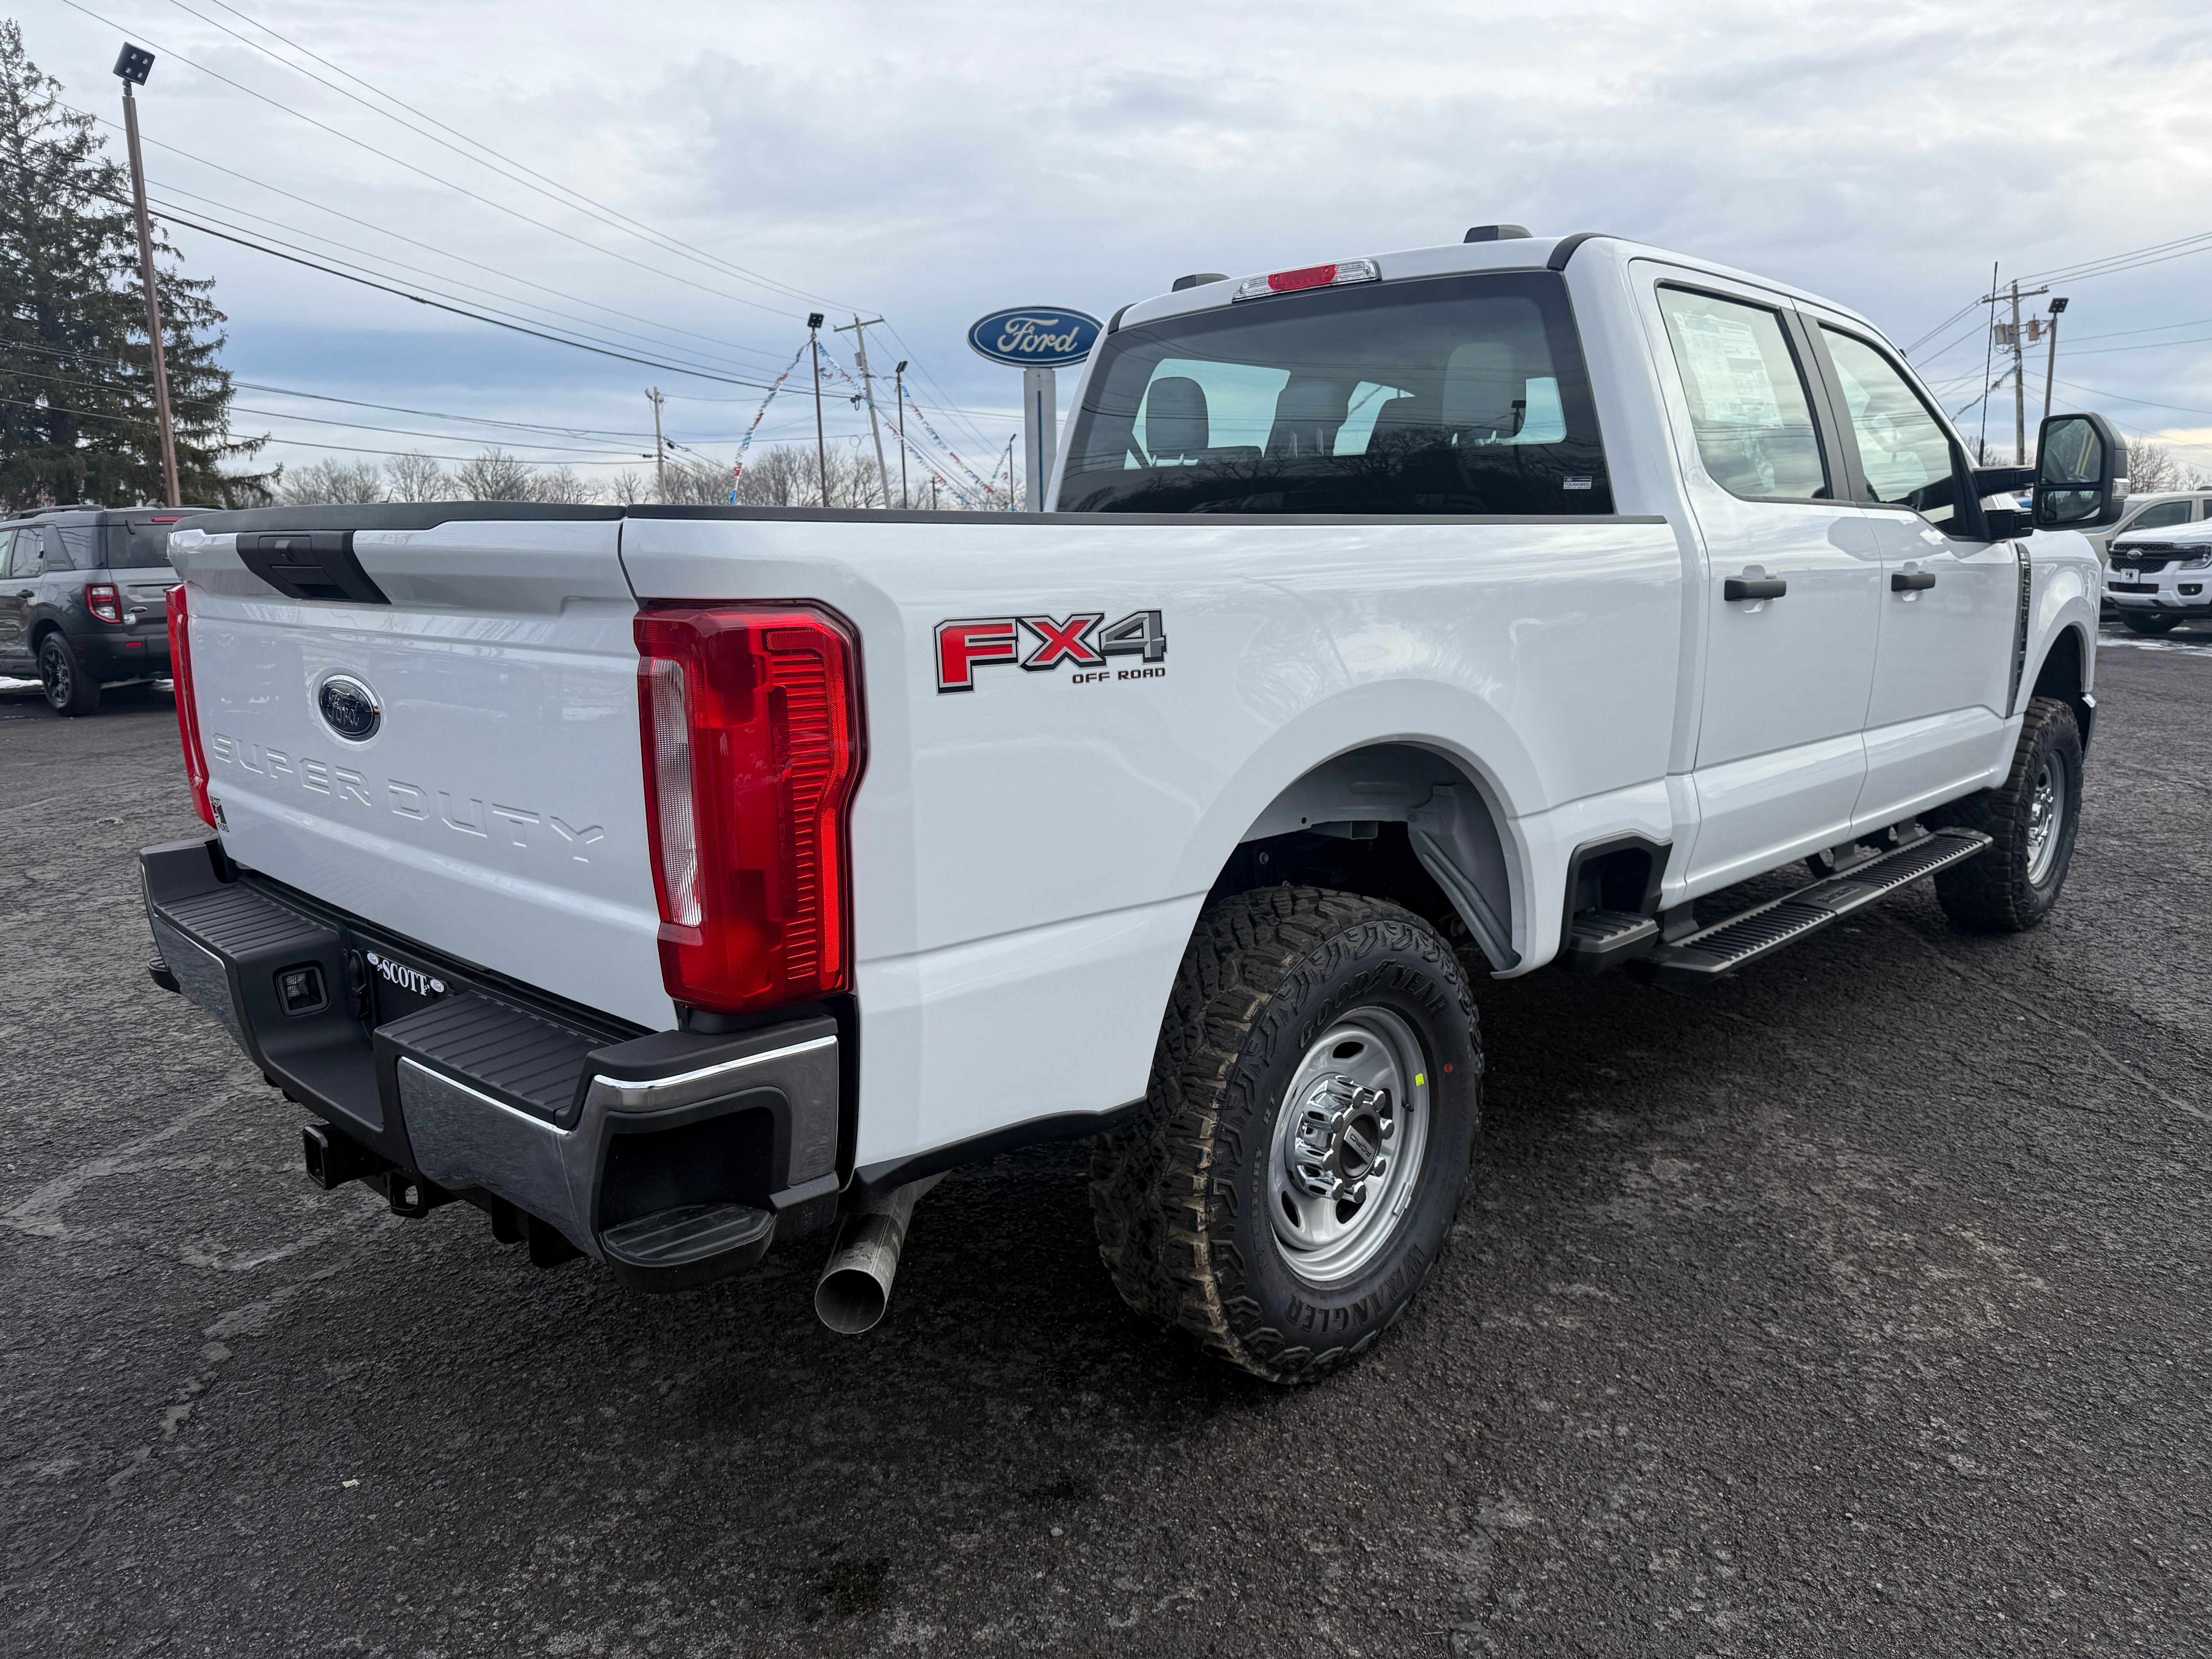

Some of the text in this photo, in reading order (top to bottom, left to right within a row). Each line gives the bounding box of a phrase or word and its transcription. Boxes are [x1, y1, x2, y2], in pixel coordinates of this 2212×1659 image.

[997, 318, 1080, 353] Ford
[932, 608, 1168, 696] FX4
[1072, 667, 1166, 684] OFF ROAD
[327, 688, 360, 726] Ford
[213, 732, 604, 863] SUPER DUTY
[382, 959, 427, 996] SCOTT
[1300, 960, 1449, 1049] GOODYEAR
[1350, 1133, 1371, 1157] FORD
[1285, 1243, 1426, 1335] WRANGLER
